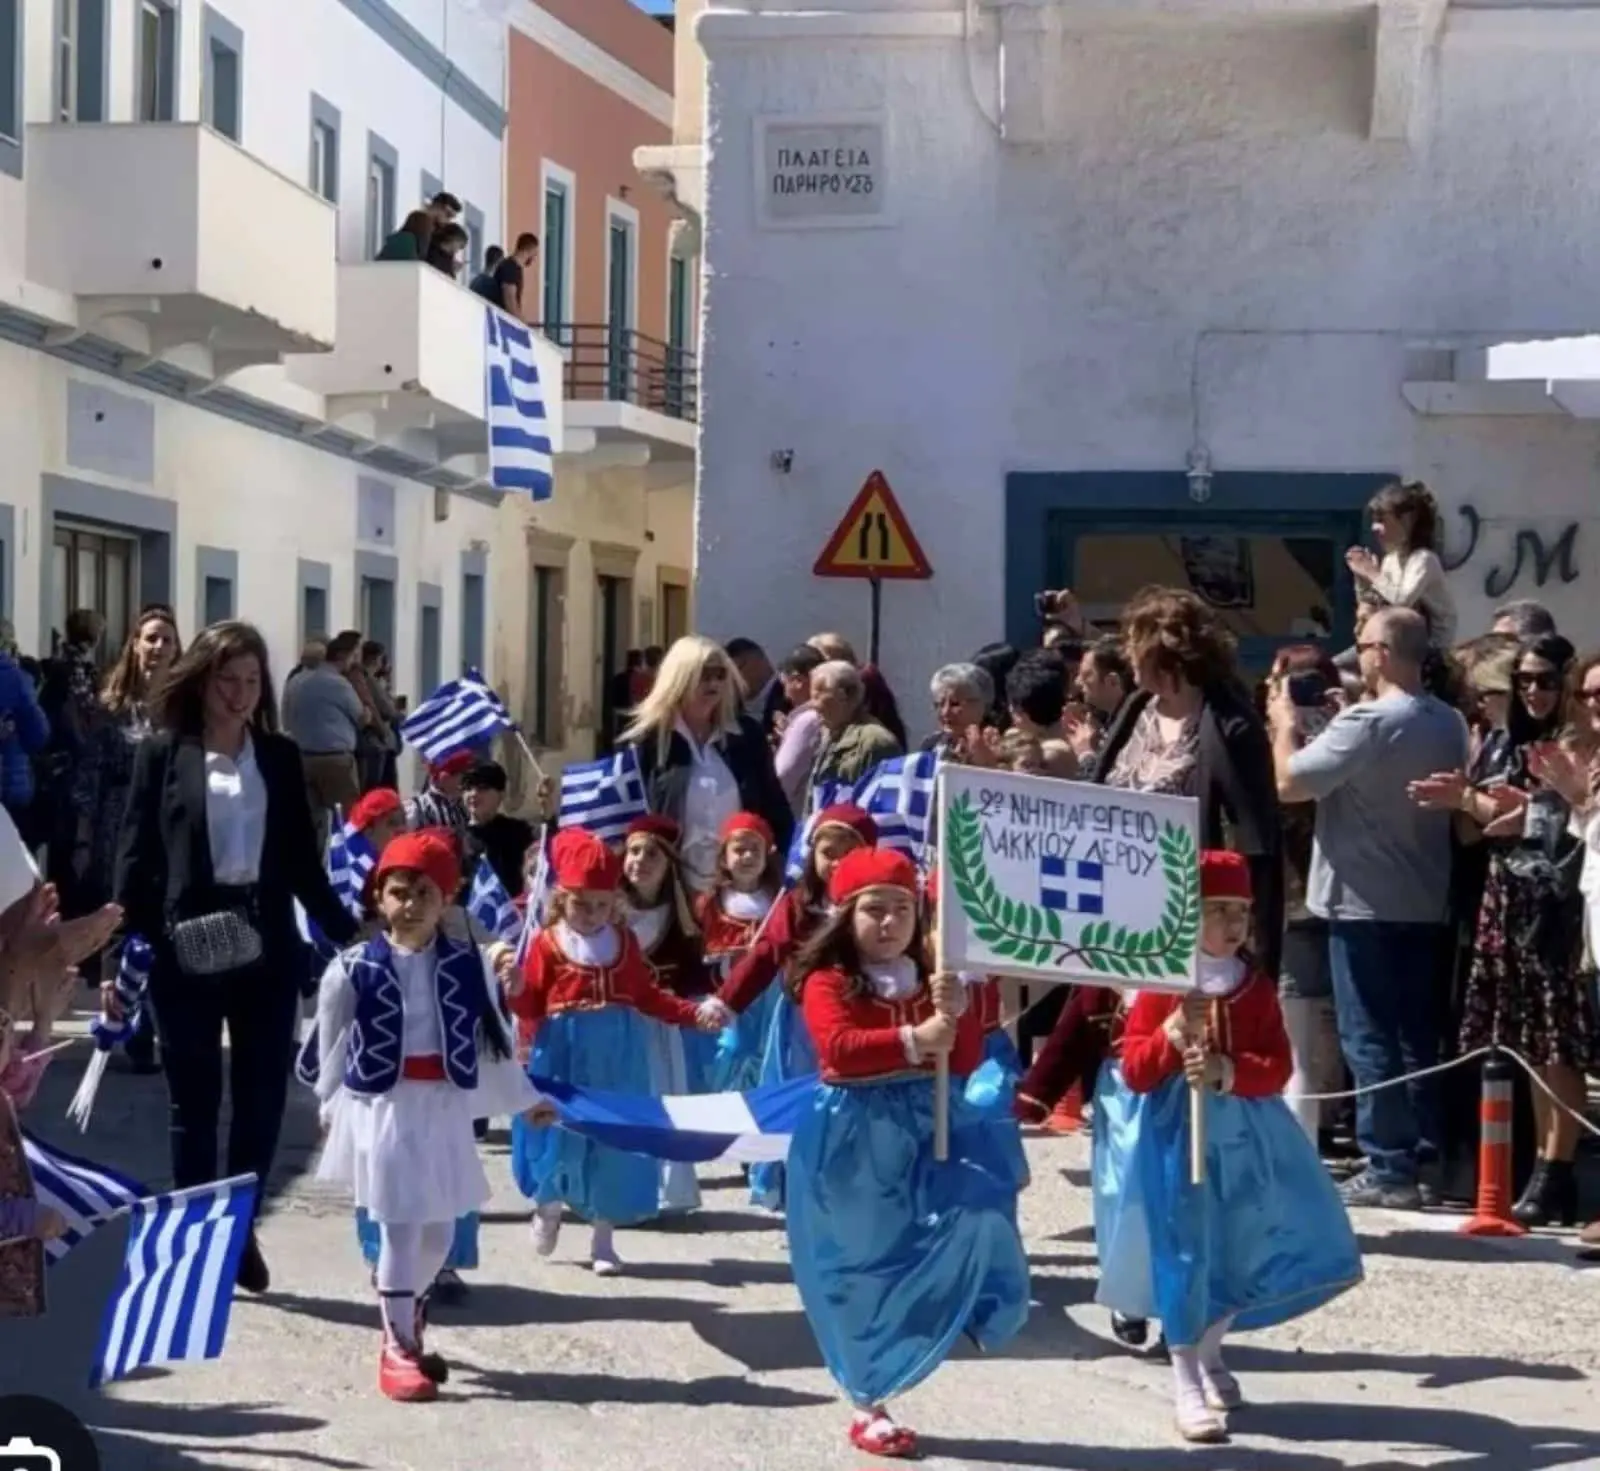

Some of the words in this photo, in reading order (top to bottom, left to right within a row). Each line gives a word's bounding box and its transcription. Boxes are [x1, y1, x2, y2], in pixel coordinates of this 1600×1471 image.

[777, 148, 870, 168] ΠΛΑΤΕΙΑ
[981, 820, 1077, 861] ΛΑΚΚΙΟΥ
[1084, 837, 1158, 877] ΛΕΡΟΥ
